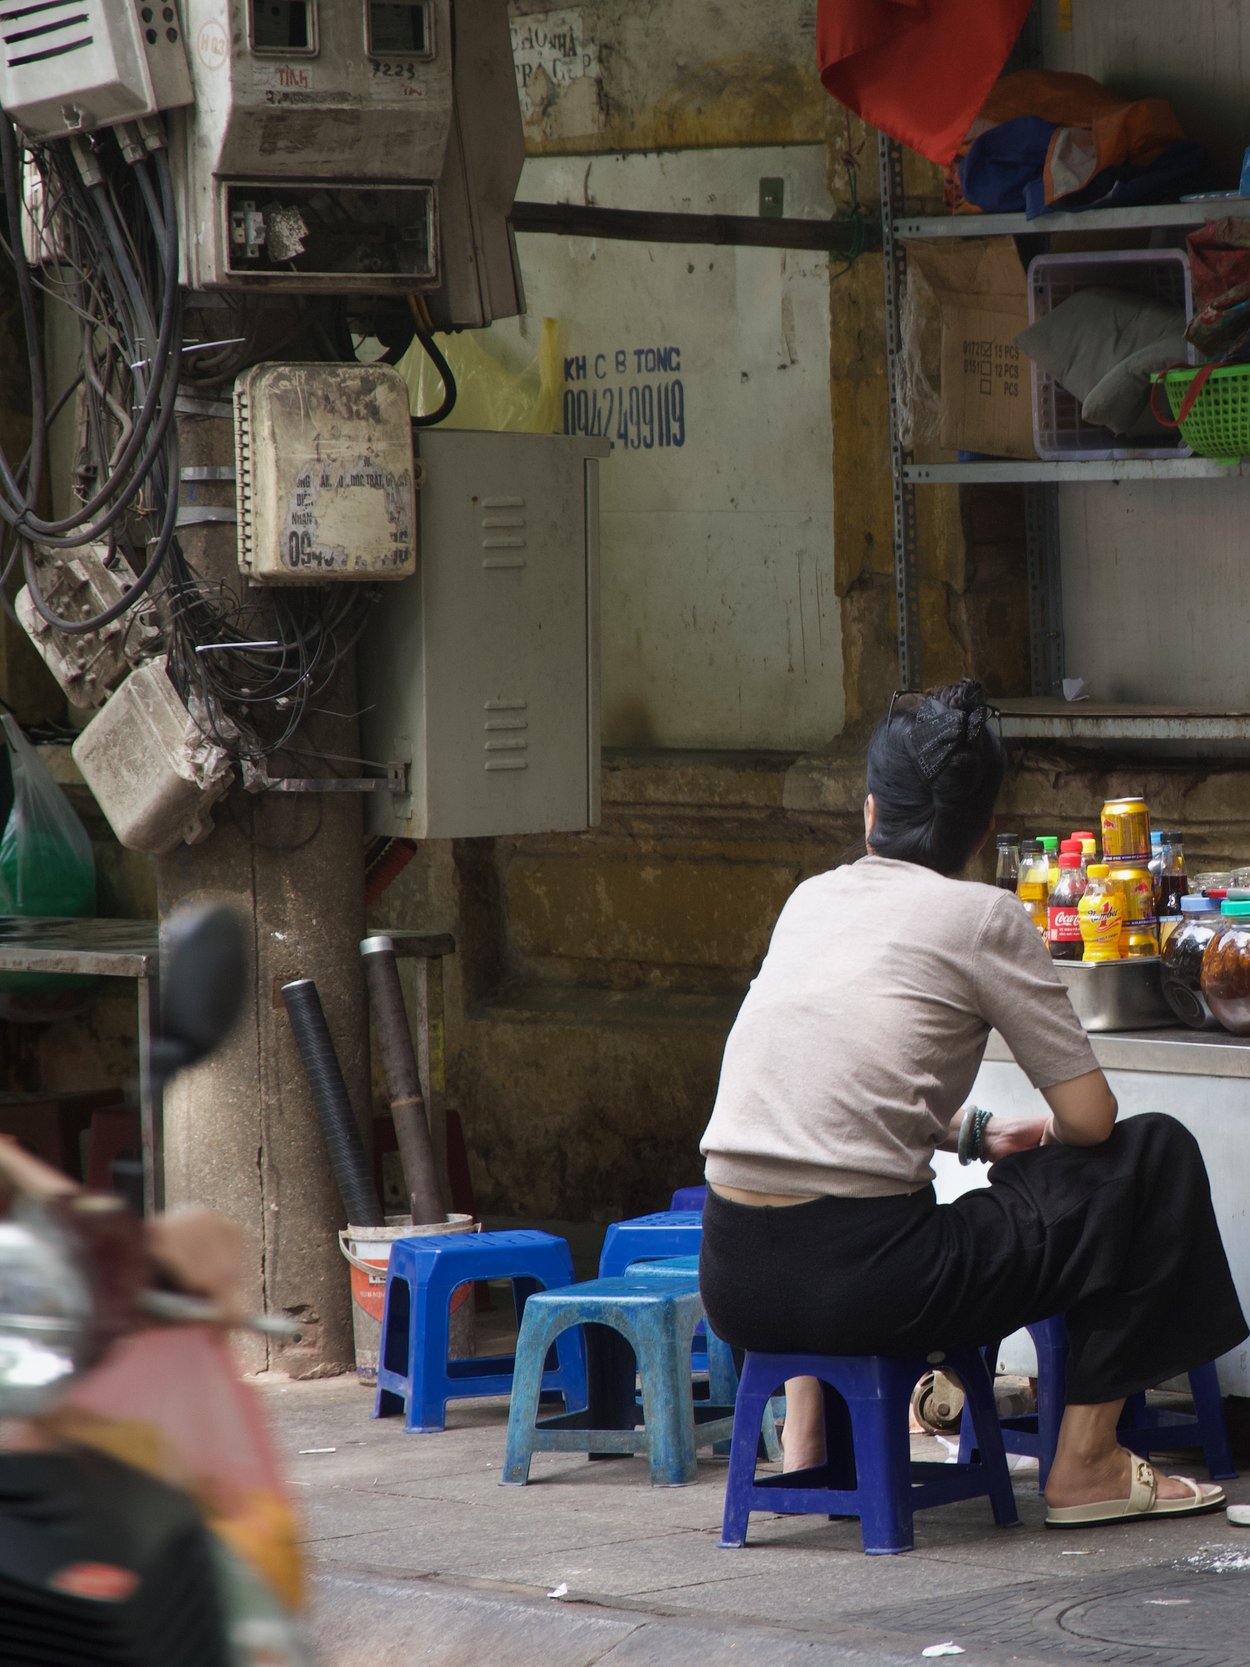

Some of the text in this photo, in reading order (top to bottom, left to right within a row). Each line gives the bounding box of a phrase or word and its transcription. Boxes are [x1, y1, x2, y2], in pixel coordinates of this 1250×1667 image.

[995, 344, 1003, 359] 15
[1004, 344, 1020, 360] PCS
[995, 364, 1003, 378] 12
[1004, 363, 1019, 379] PCS
[1004, 381, 1019, 397] PCS
